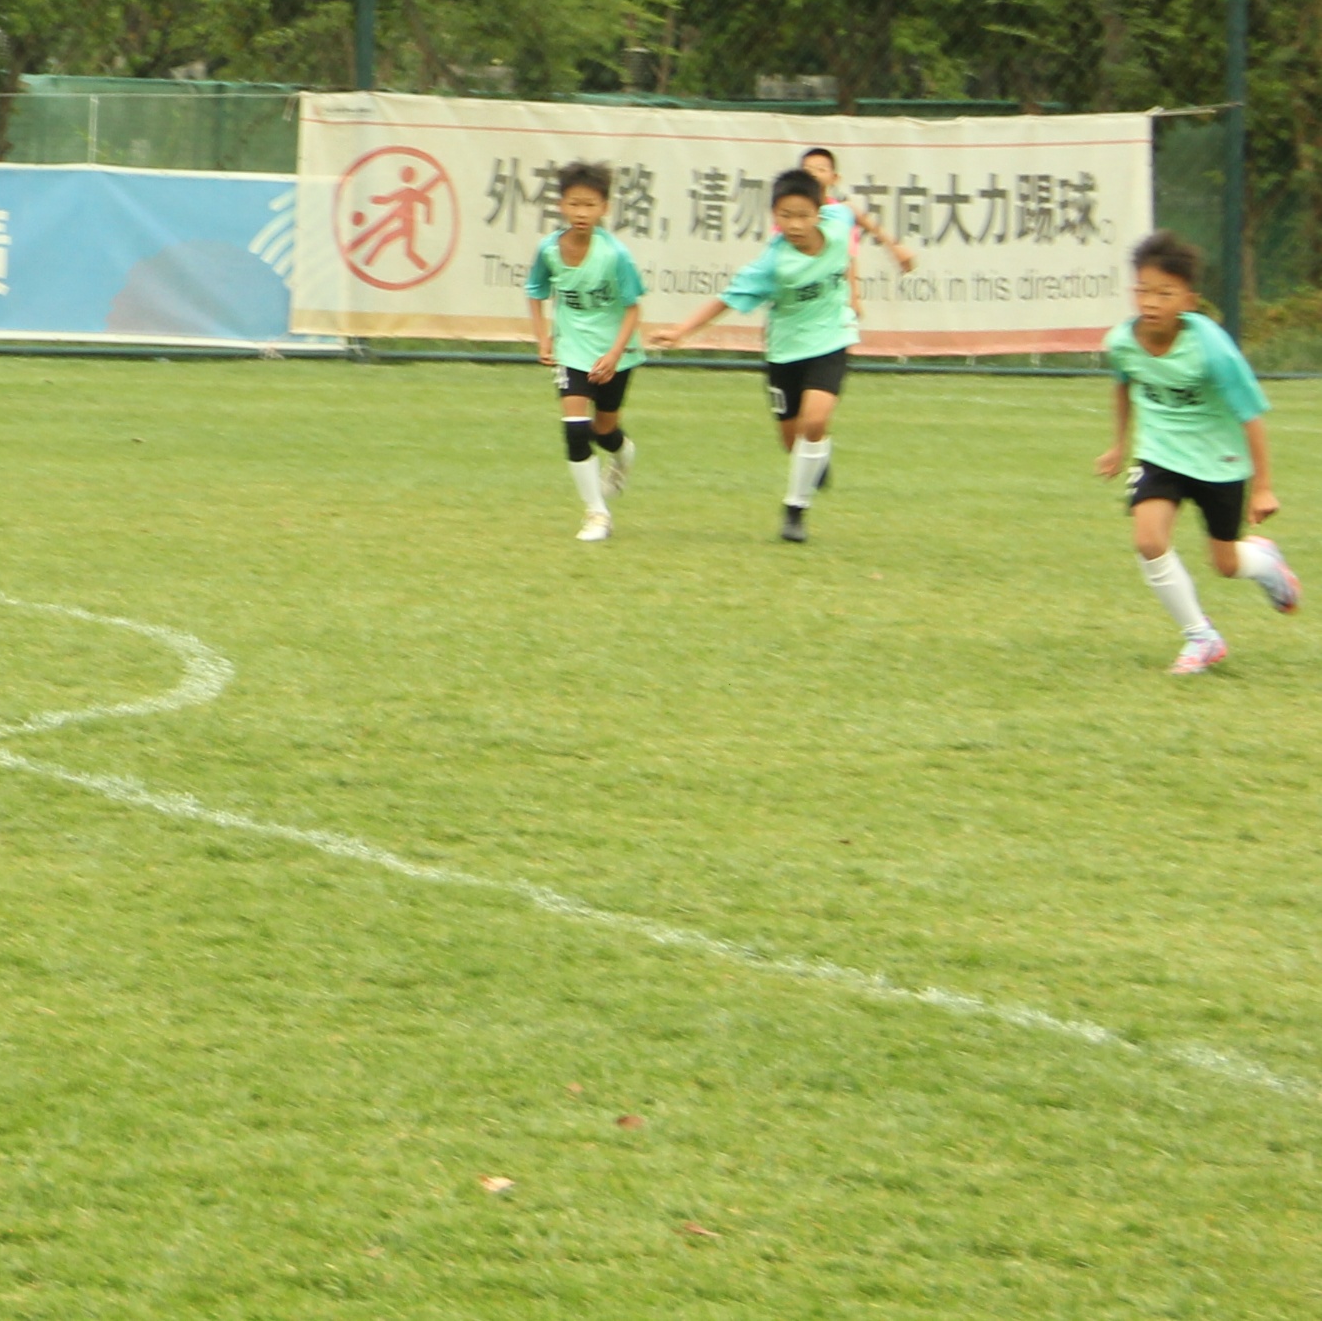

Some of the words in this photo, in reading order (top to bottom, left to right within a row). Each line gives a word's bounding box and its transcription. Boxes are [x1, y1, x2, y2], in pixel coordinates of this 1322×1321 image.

[483, 156, 1115, 247] 外有路，请勿方向大力踢球。
